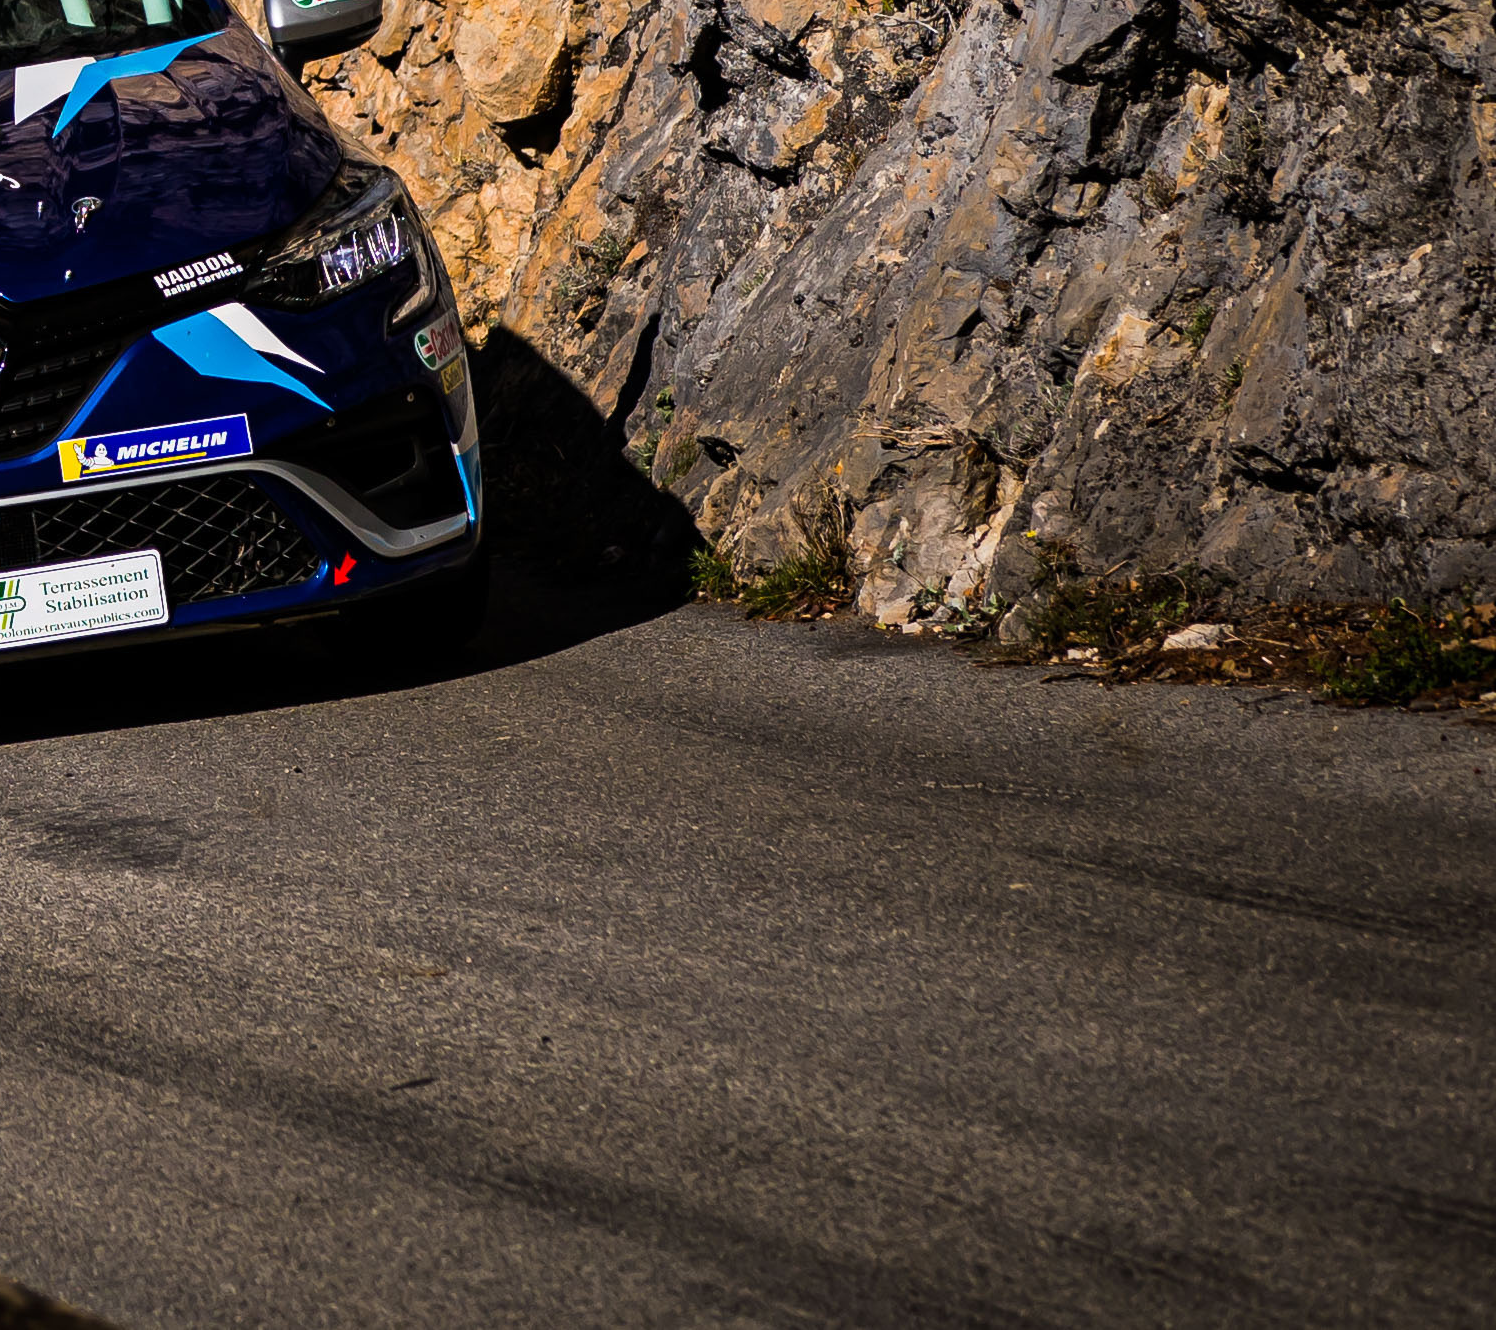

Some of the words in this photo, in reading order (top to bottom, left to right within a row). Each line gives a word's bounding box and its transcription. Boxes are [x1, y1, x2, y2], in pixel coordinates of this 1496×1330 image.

[153, 252, 235, 289] NAUDON
[162, 280, 198, 298] Rallye
[197, 264, 244, 286] Services
[116, 431, 228, 461] MICHELIN
[38, 567, 150, 596] Terrassement
[45, 588, 149, 614] Stabilisation
